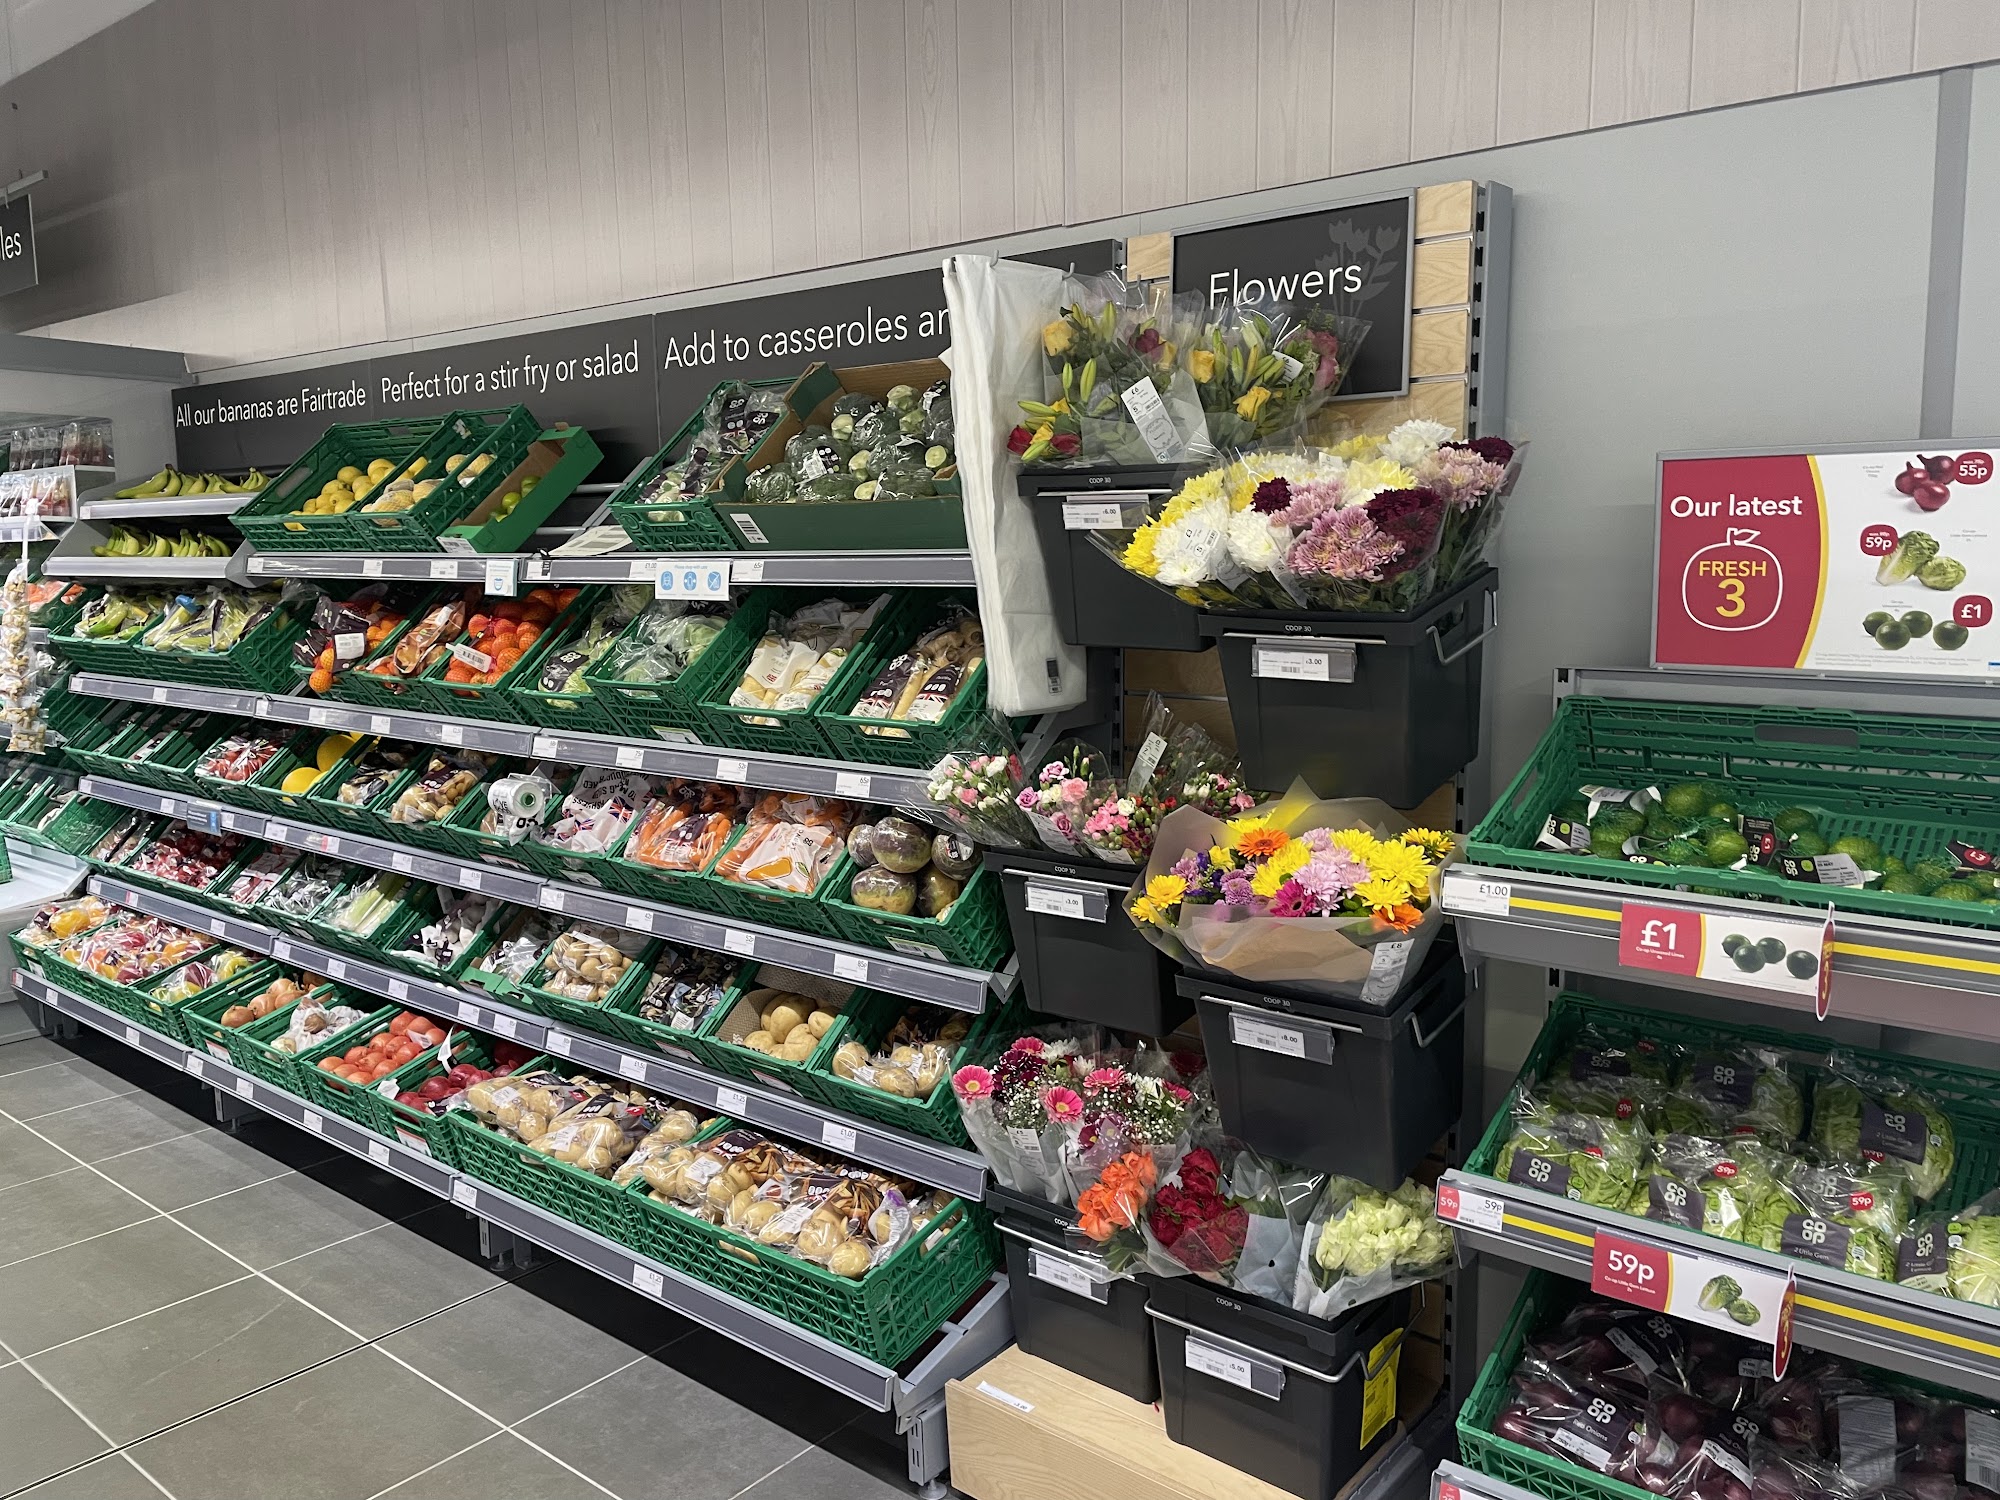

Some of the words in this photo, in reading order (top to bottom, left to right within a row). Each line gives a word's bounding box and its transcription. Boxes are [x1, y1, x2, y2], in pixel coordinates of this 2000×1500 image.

[1210, 264, 1362, 309] Flowers
[665, 329, 715, 370] Add
[723, 334, 749, 362] to
[758, 306, 907, 358] casseroles
[382, 372, 441, 402] Perfect
[444, 366, 470, 395] for
[475, 372, 485, 392] a
[490, 360, 519, 390] stir
[523, 354, 549, 393] fry
[555, 359, 577, 381] or
[583, 339, 638, 379] salad
[176, 403, 191, 427] All
[195, 407, 214, 426] our
[219, 400, 273, 423] bananas
[277, 398, 298, 417] are
[302, 380, 366, 413] Fairtrade
[1958, 464, 1988, 479] 55p
[1670, 495, 1722, 517] Our
[1728, 494, 1803, 516] latest
[1865, 537, 1892, 551] 59p
[1698, 560, 1767, 577] FRESH
[1715, 578, 1747, 618] 3
[1961, 604, 1982, 619] £1
[860, 776, 870, 784] 65p
[1479, 884, 1508, 897] £1.00
[1640, 920, 1677, 950] £1
[1264, 996, 1281, 1006] COOP
[1282, 999, 1290, 1007] 30
[1281, 1034, 1298, 1044] £8.00
[732, 1094, 746, 1102] £1.25
[1618, 1103, 1632, 1112] 59p
[840, 1128, 855, 1138] £1.00
[1716, 1166, 1736, 1176] 59p
[1440, 1197, 1458, 1210] 59p
[1484, 1200, 1504, 1212] 59p
[1852, 1196, 1872, 1207] 59p
[1608, 1250, 1655, 1284] 59p
[1216, 1296, 1232, 1307] COOP
[1230, 1364, 1245, 1373] £5.00
[1586, 1426, 1608, 1442] Onions
